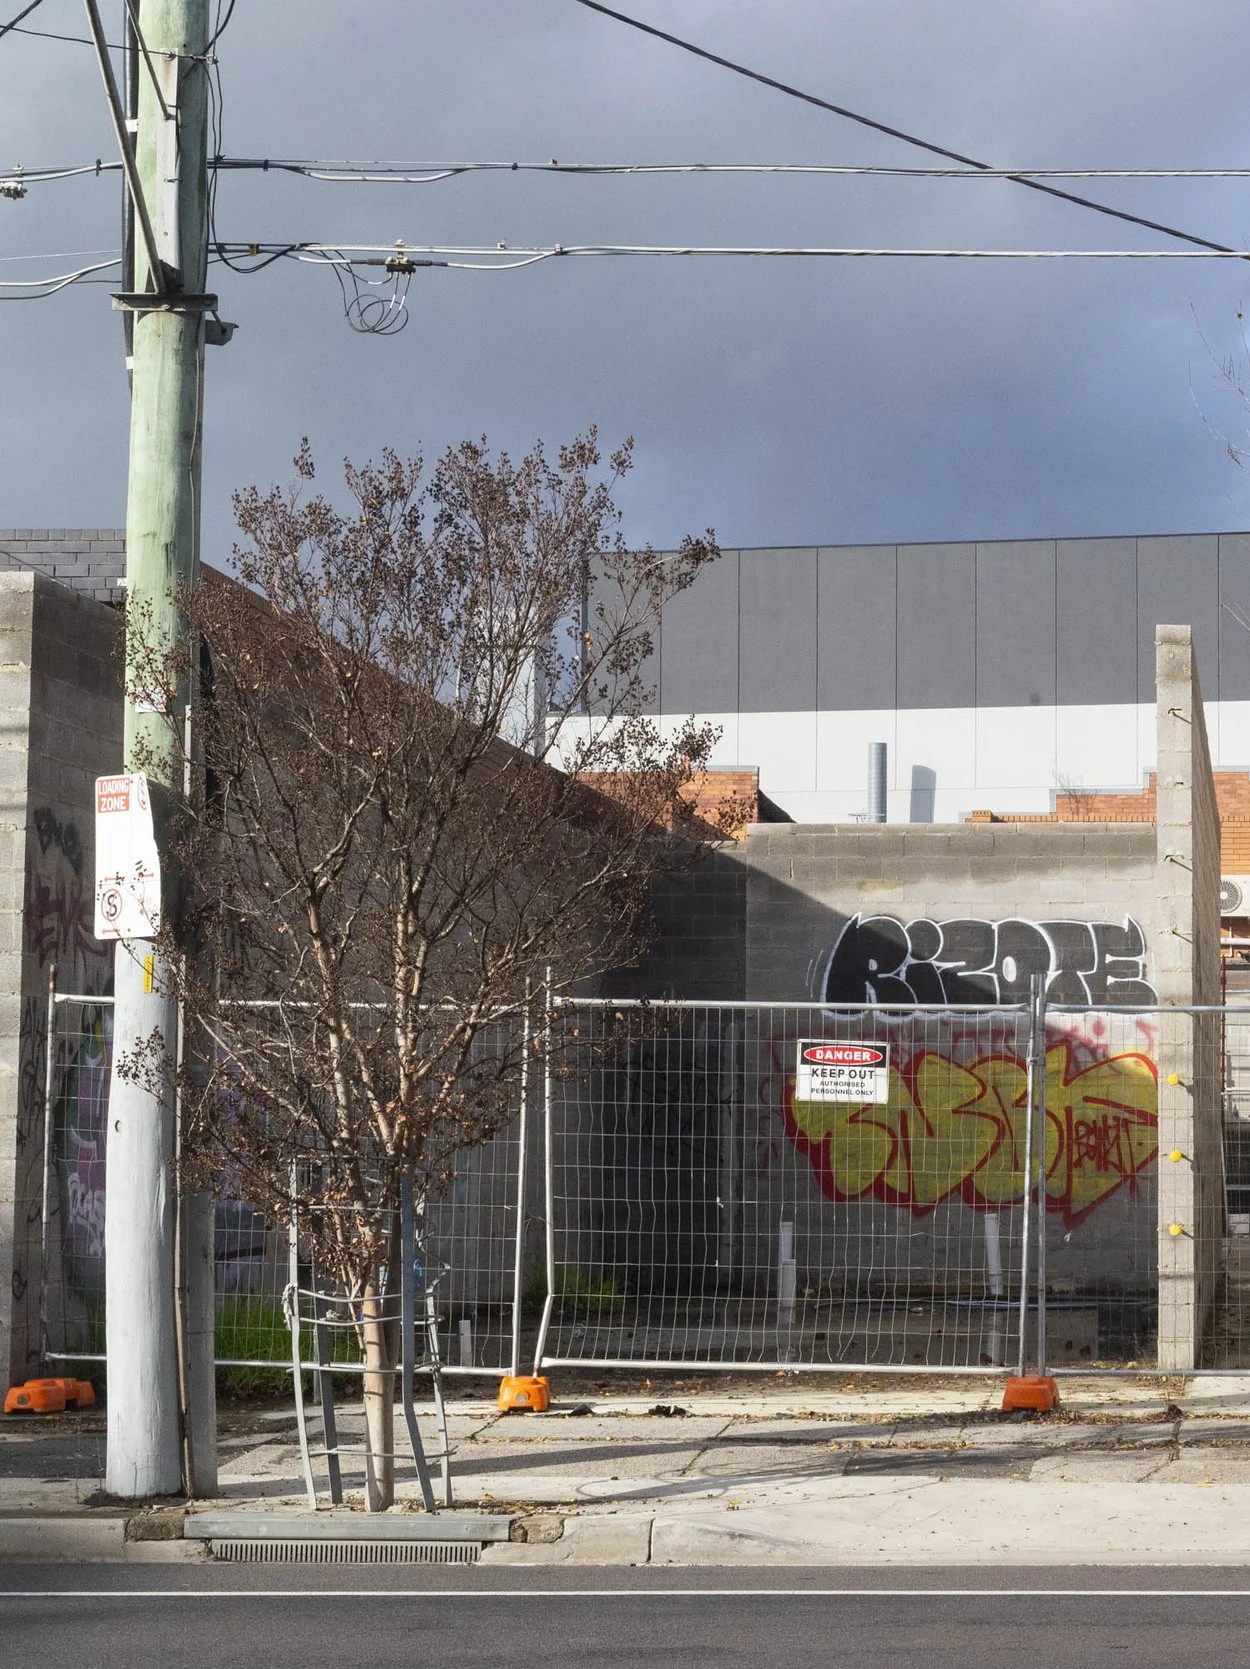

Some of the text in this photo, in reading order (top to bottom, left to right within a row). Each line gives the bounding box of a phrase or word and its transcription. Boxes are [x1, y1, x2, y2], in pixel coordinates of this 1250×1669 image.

[98, 779, 129, 795] LOADING
[101, 795, 127, 811] ZONE
[816, 1049, 871, 1061] DANGER
[811, 1068, 875, 1079] KEEP OUT
